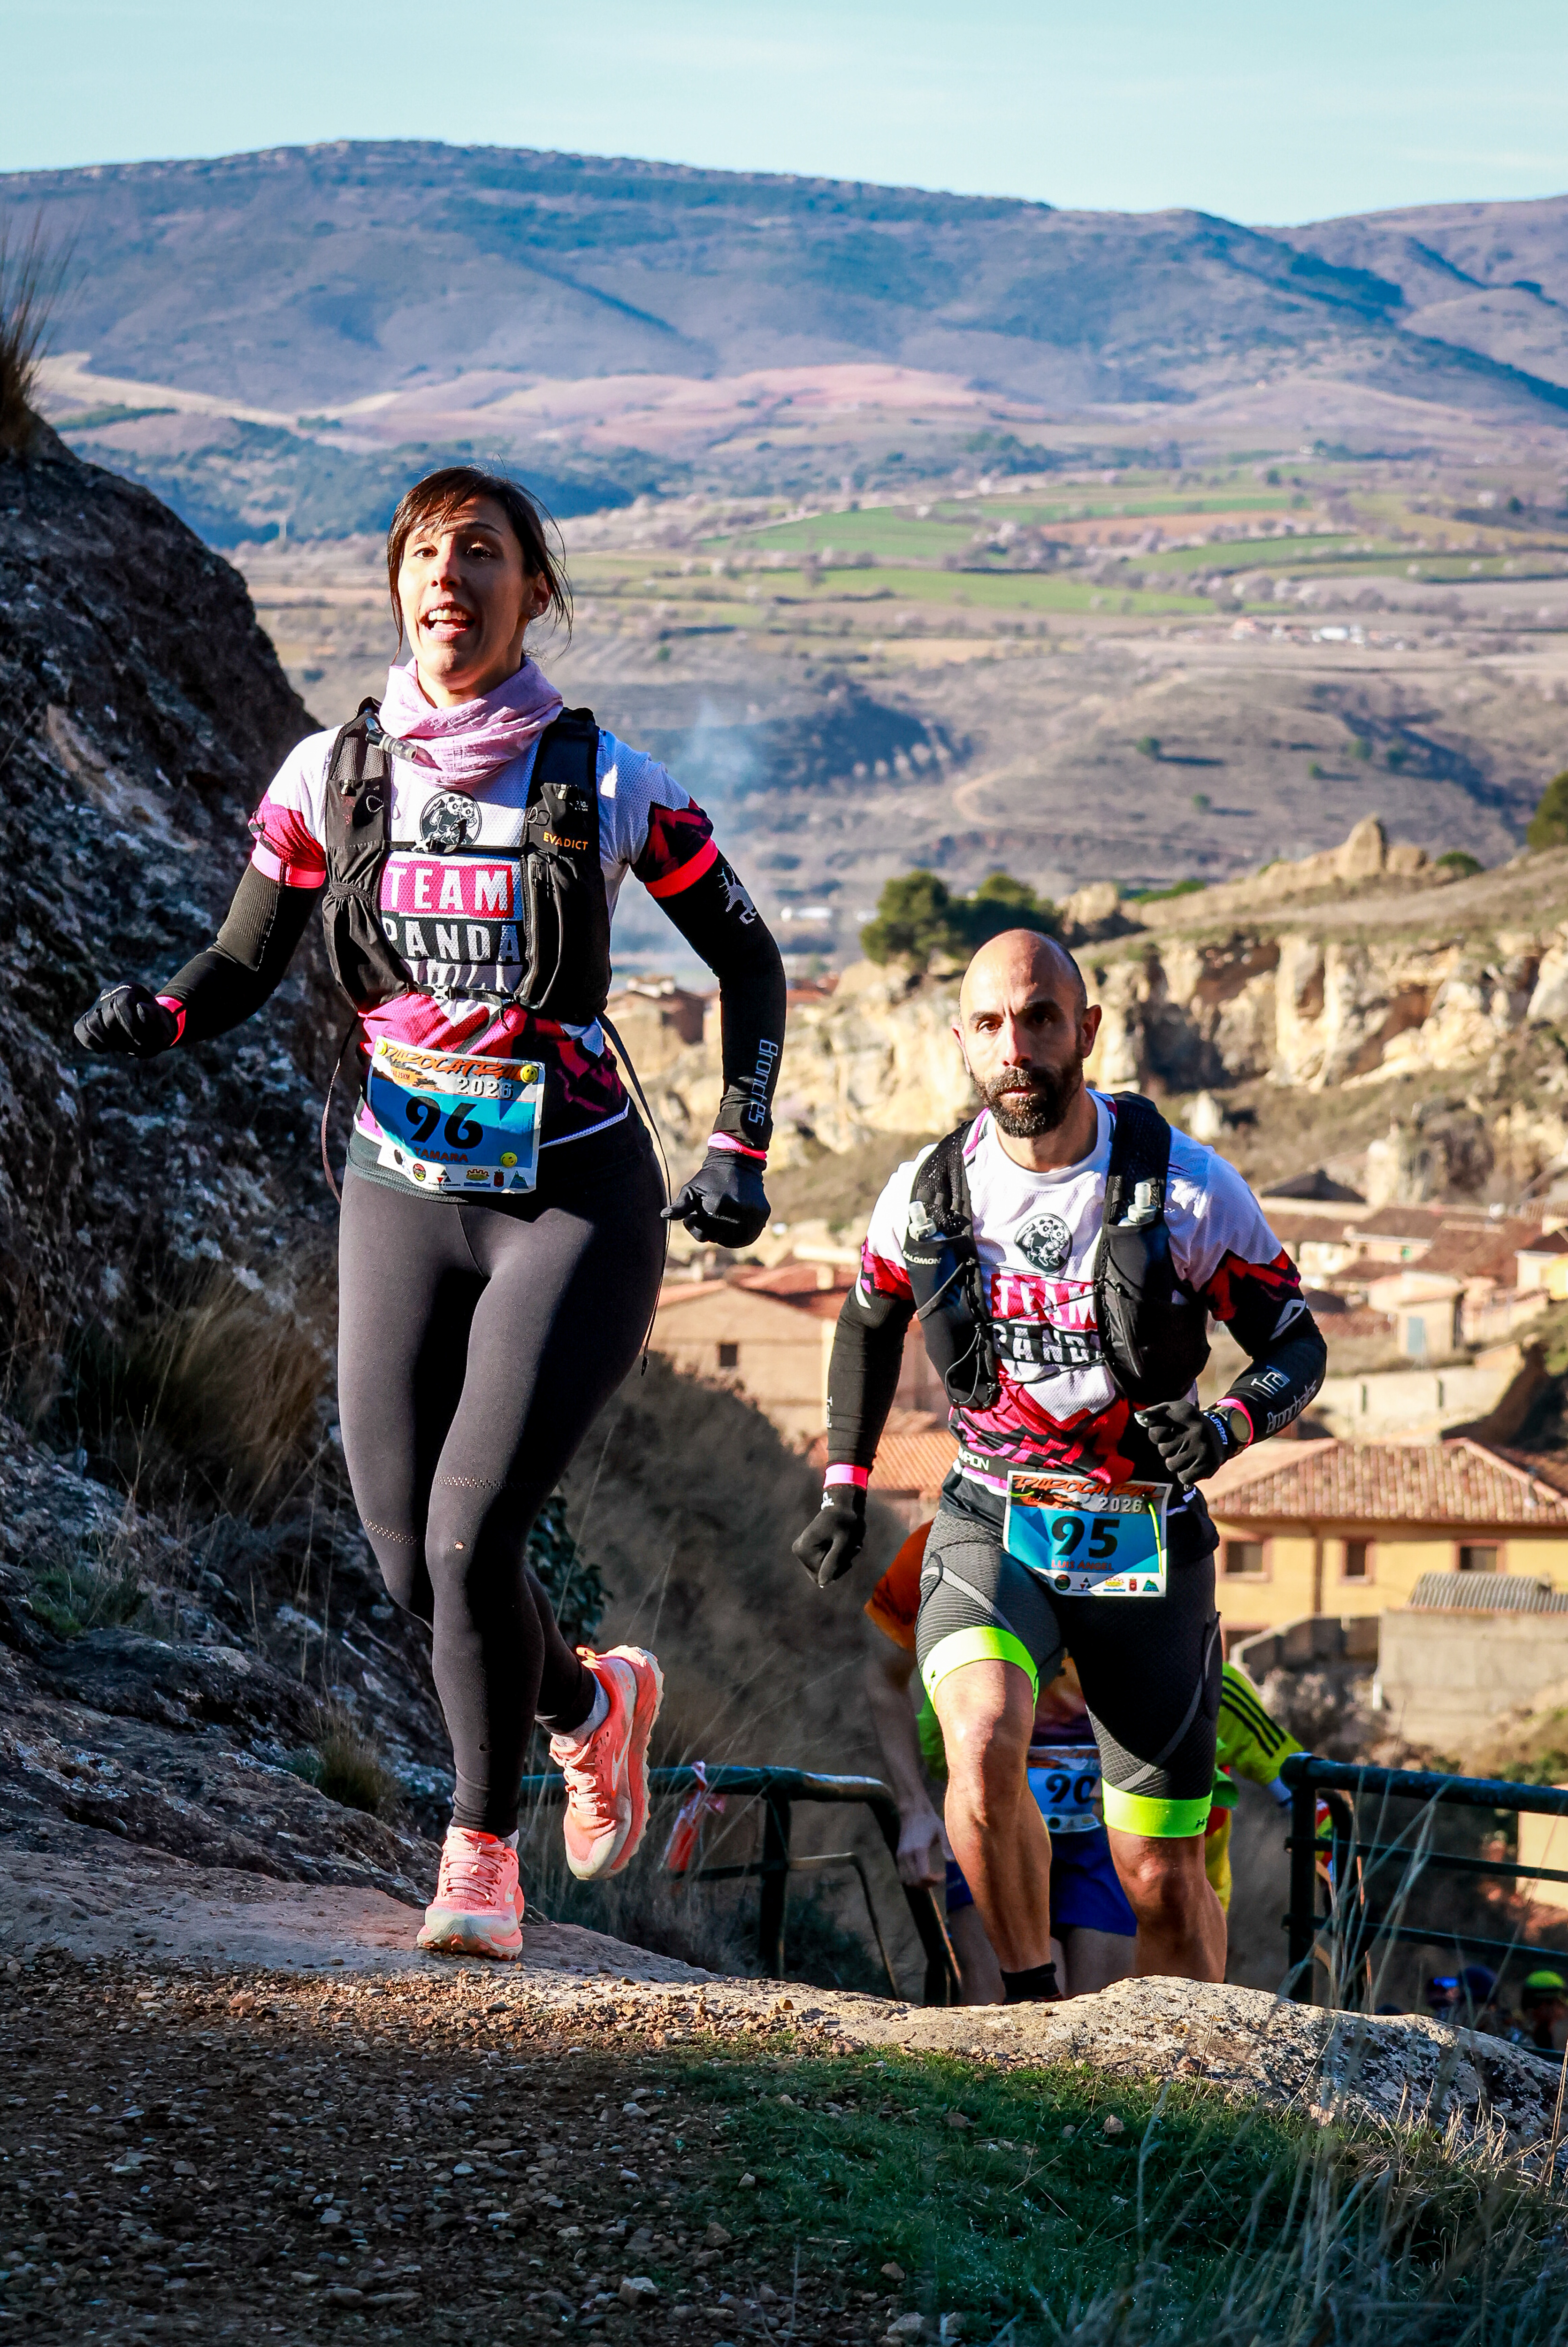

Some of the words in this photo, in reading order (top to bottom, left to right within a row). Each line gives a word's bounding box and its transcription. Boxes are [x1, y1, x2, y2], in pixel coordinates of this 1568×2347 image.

[543, 831, 589, 851] EVADICT
[387, 866, 508, 911] TEAM
[381, 916, 520, 962] PANDA
[457, 1077, 514, 1099] 2026
[405, 1096, 484, 1150] 96
[414, 1147, 469, 1163] TAMARA
[902, 1250, 942, 1265] SALOMON
[995, 1279, 1097, 1324] TEAM
[1099, 1497, 1143, 1513] 2026
[1051, 1516, 1120, 1559] 95
[1051, 1559, 1074, 1569] LUIS
